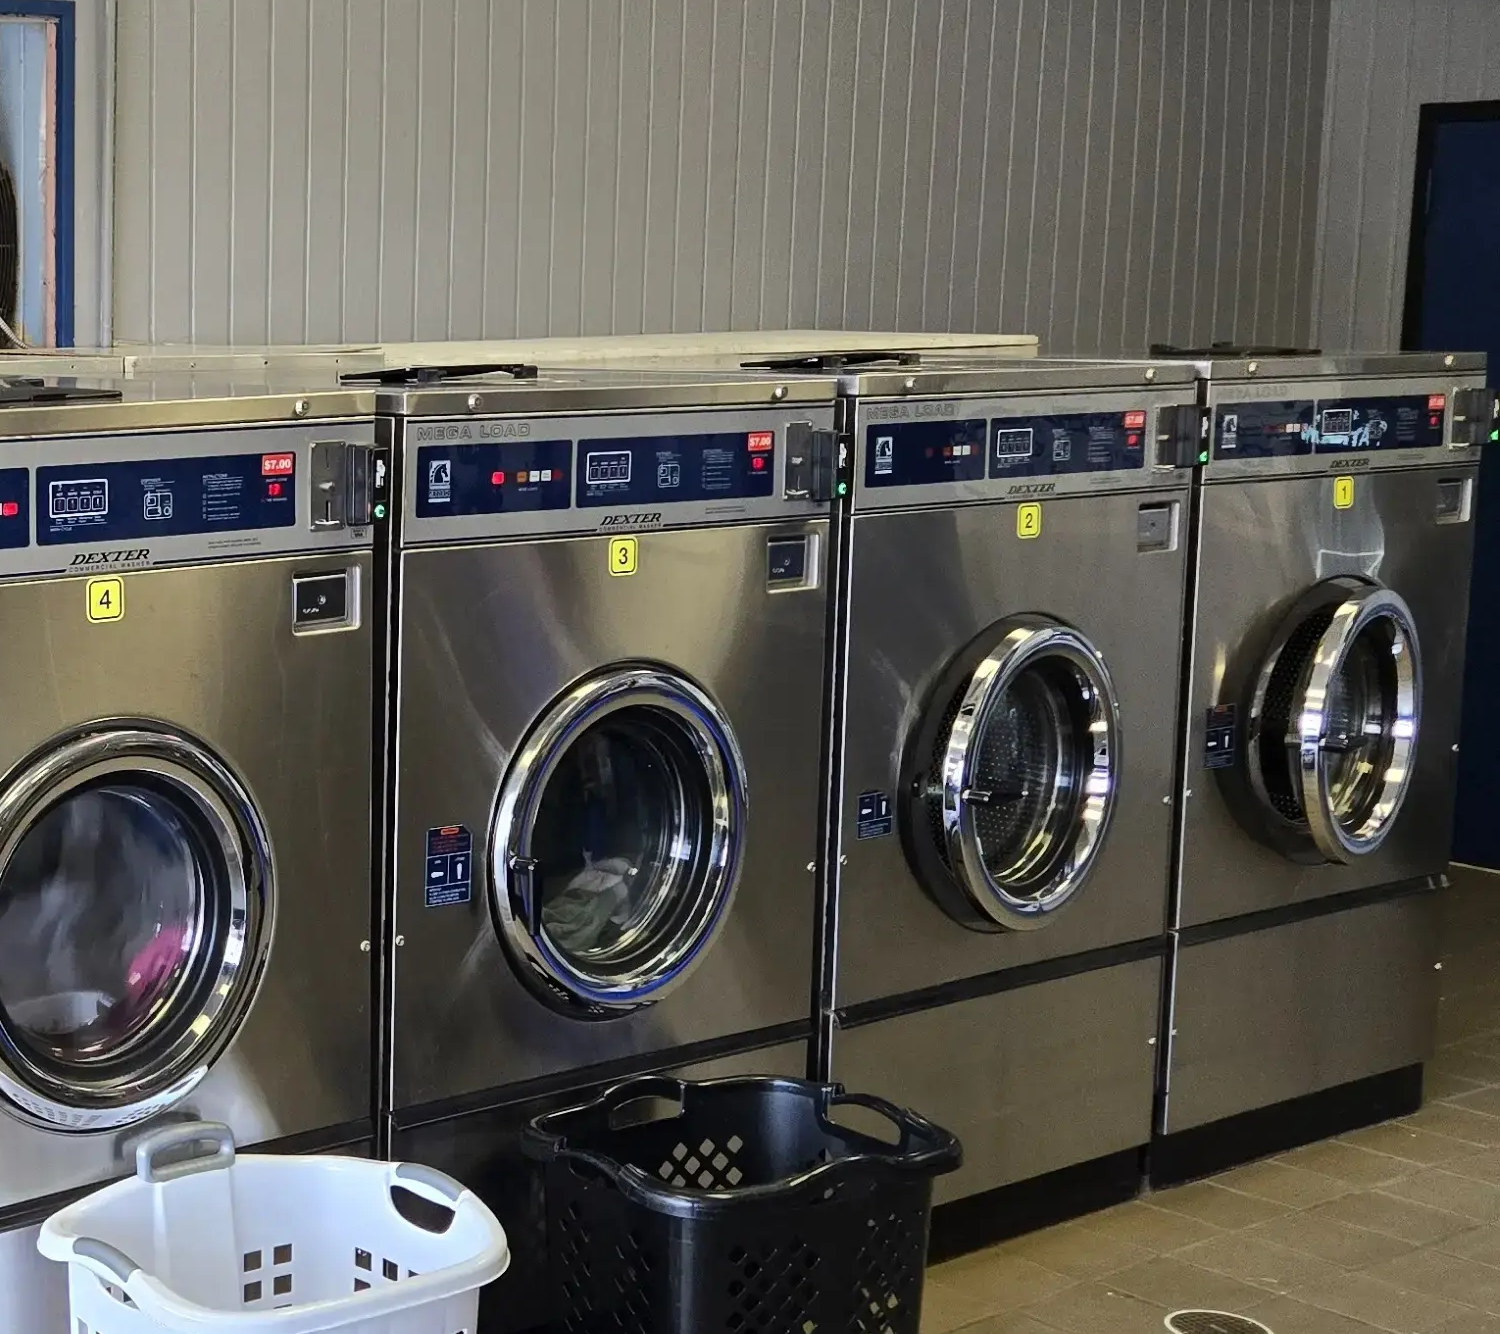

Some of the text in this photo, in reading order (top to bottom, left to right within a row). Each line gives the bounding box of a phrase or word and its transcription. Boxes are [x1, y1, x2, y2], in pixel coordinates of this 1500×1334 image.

[417, 423, 531, 441] MEGA LOAD
[264, 458, 292, 471] $7.00
[1006, 482, 1056, 495] DEXTER
[1342, 485, 1347, 500] 1
[600, 513, 661, 526] DEXTER
[1025, 513, 1033, 529] 2
[70, 549, 151, 565] DEXTER
[618, 547, 628, 564] 3
[100, 589, 112, 609] 4
